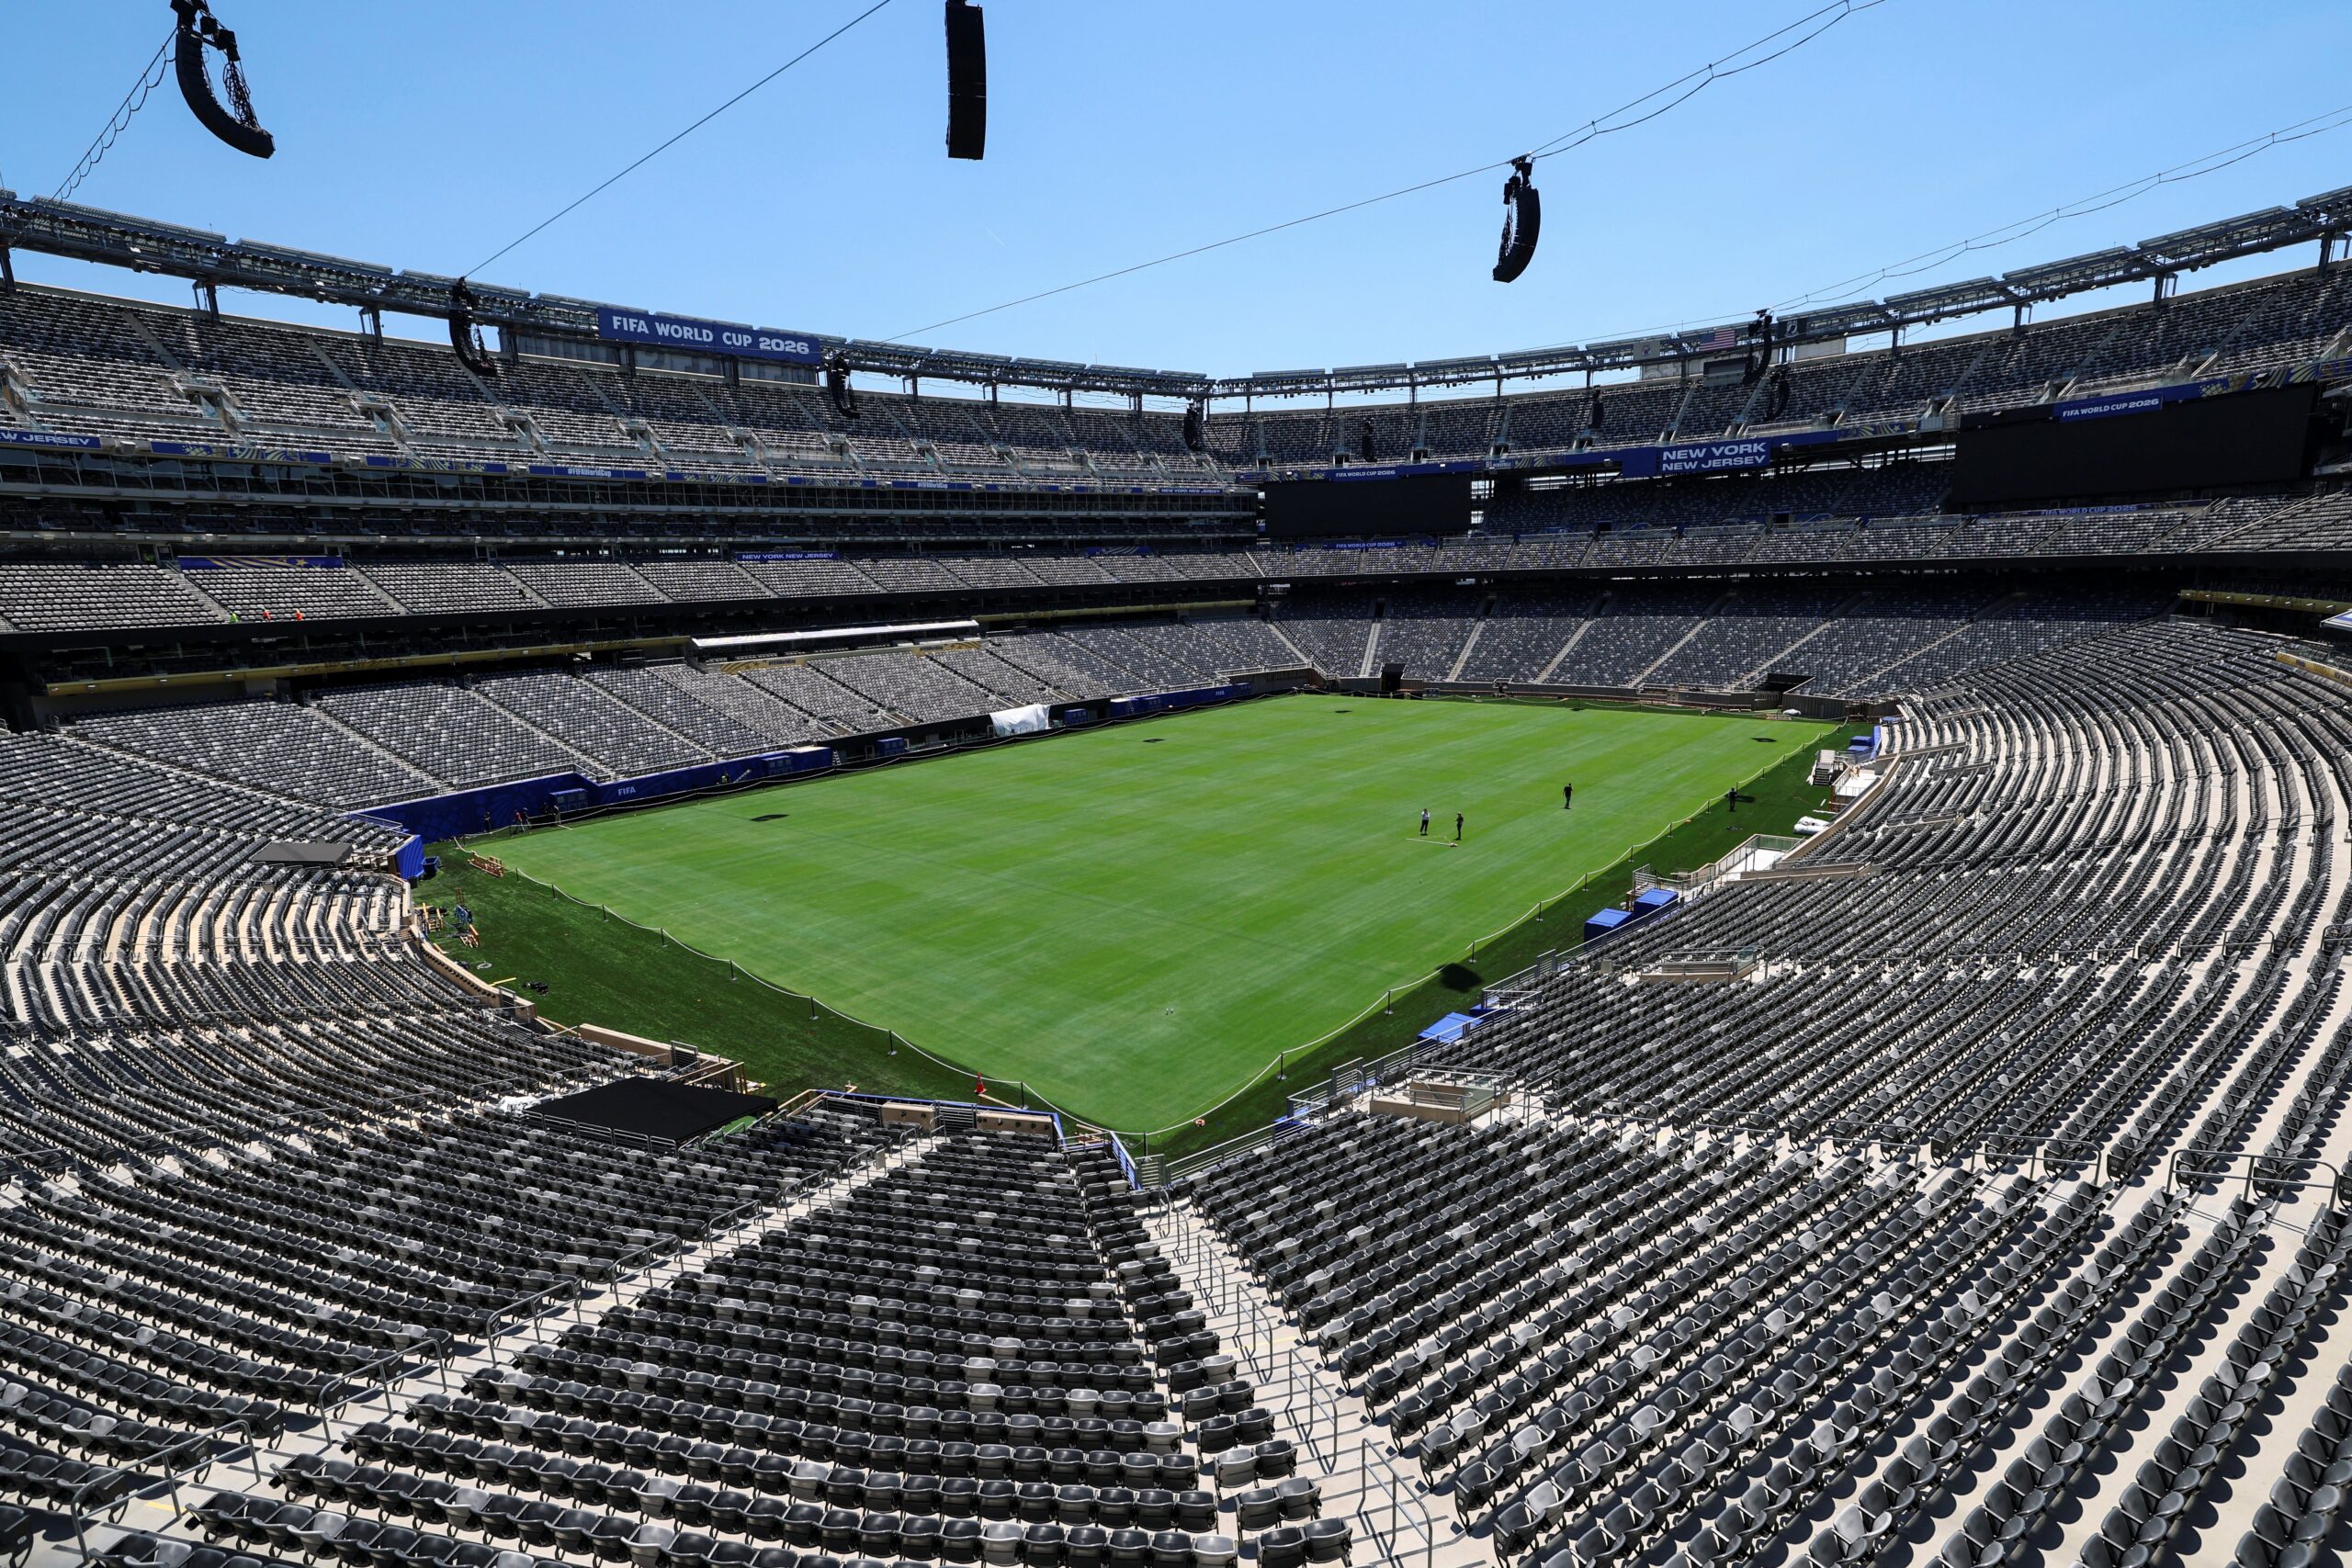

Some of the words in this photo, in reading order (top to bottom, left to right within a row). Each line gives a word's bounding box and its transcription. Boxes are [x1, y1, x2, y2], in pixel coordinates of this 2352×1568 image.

[612, 315, 650, 334] FIFA
[655, 321, 714, 343] WORLD
[722, 332, 752, 347] CUP
[758, 337, 809, 355] 2026
[2063, 409, 2080, 417] FIFA
[2080, 405, 2110, 415] WORLD
[2110, 402, 2128, 411] CUP
[2128, 398, 2159, 409] 2026
[22, 434, 90, 446] JERSEY
[1662, 447, 1707, 461] NEW
[1711, 442, 1767, 457] YORK
[1662, 460, 1699, 471] NEW
[1701, 455, 1766, 468] JERSEY
[617, 785, 637, 796] FIFA
